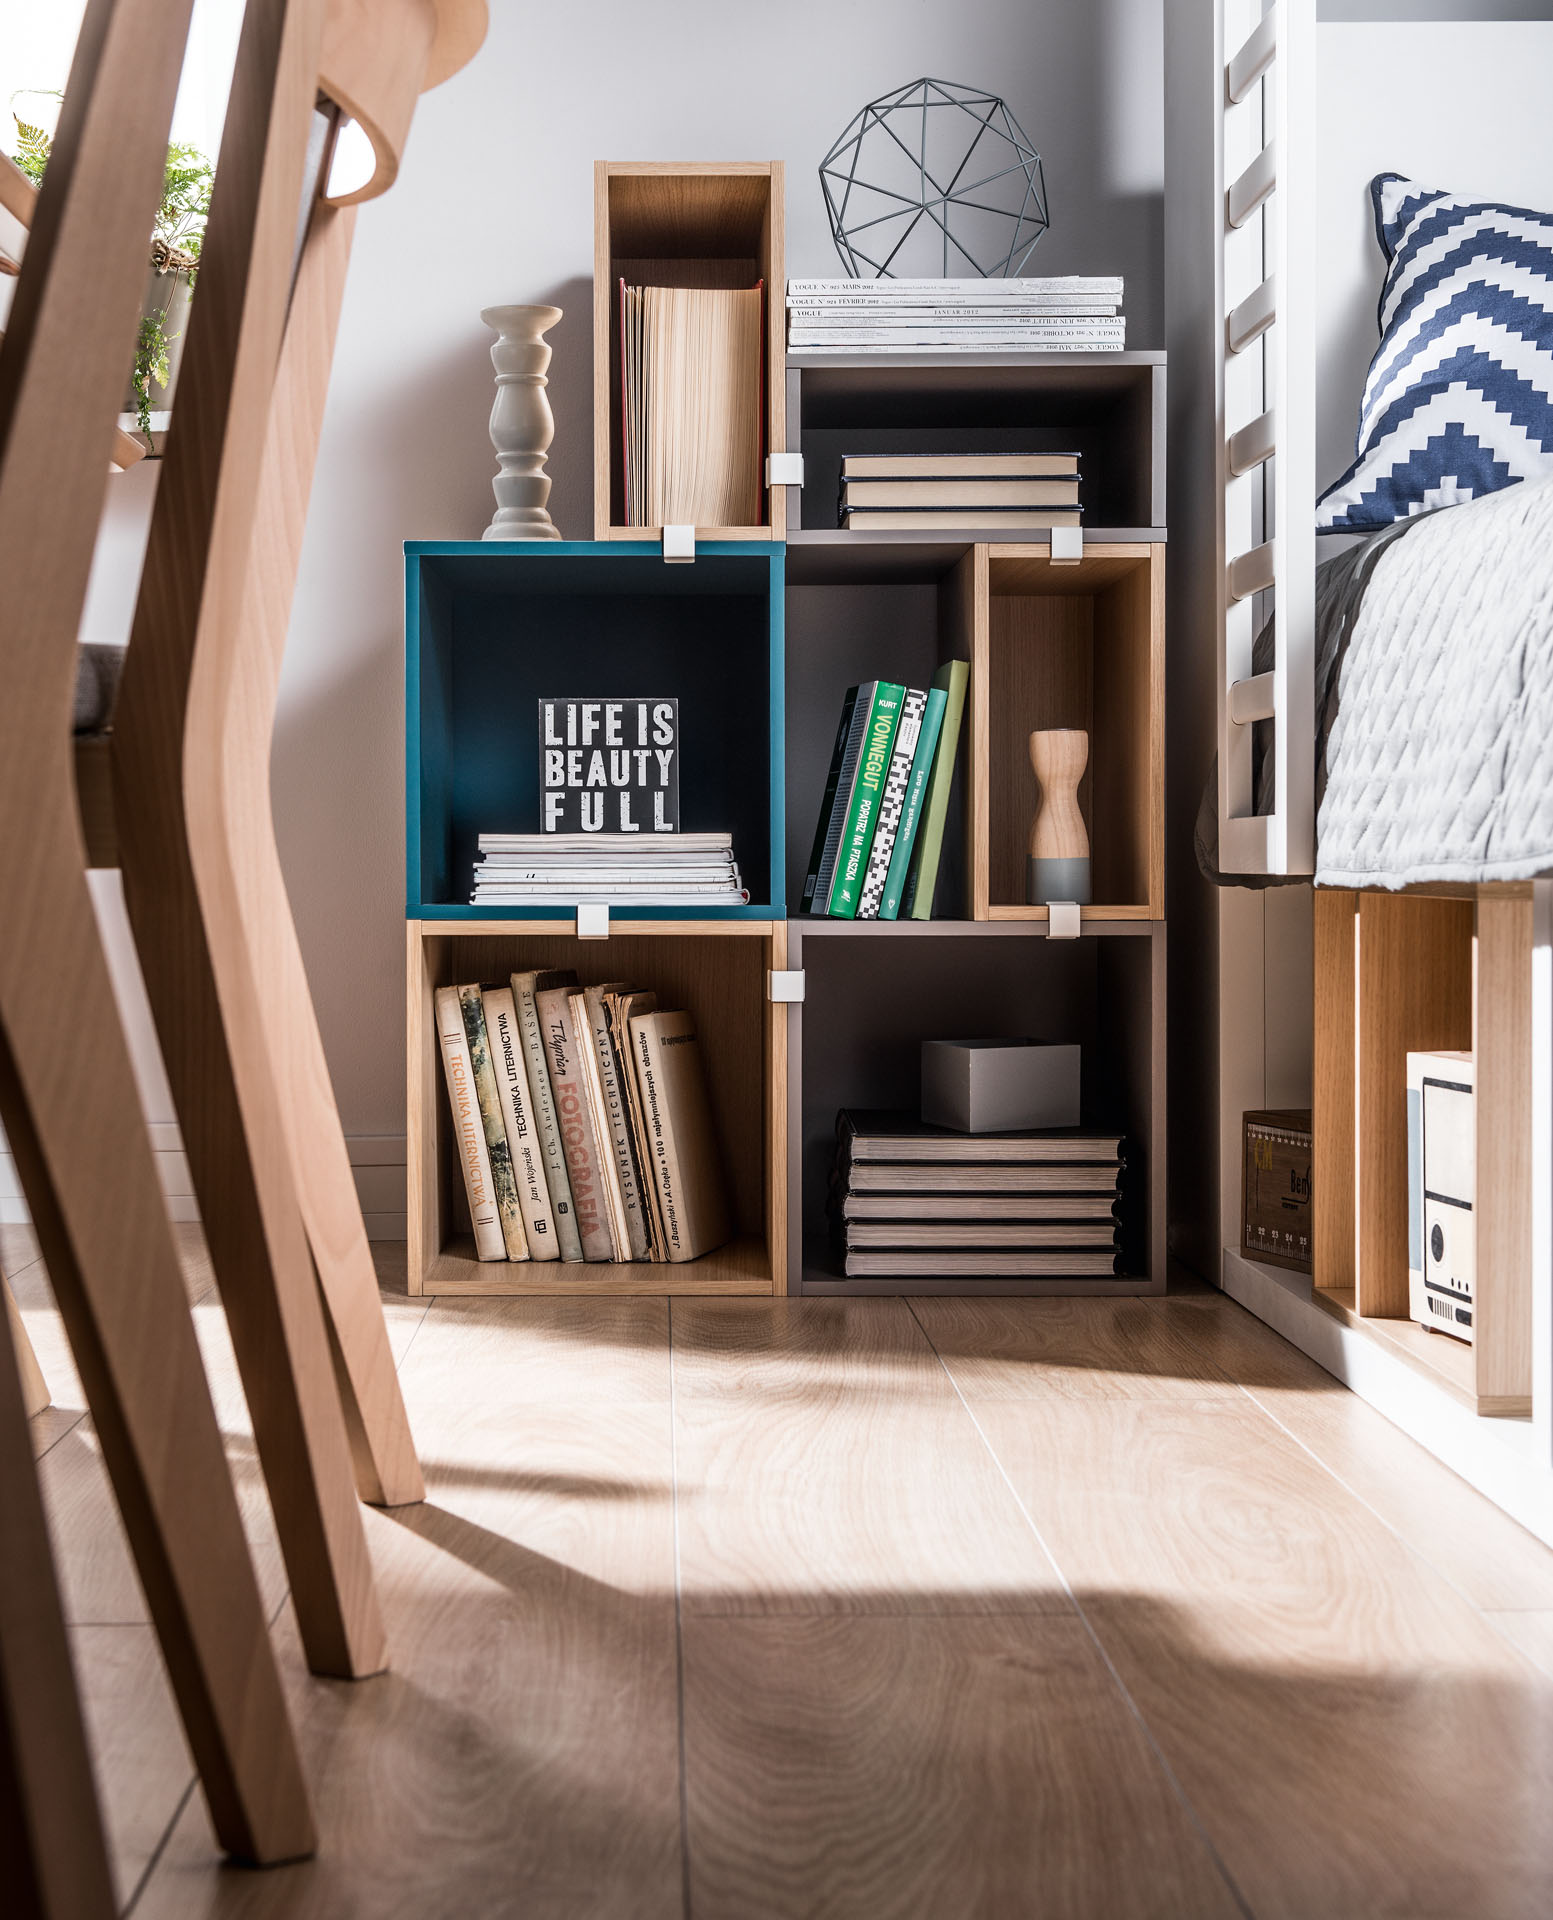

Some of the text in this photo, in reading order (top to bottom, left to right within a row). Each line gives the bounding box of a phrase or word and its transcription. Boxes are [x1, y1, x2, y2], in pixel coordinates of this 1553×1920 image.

[545, 703, 674, 746] LIFE IS
[878, 699, 897, 709] KURT
[545, 750, 674, 787] BEAUTY
[545, 792, 673, 832] FULL
[845, 715, 893, 881] VONNEGUT POPATRZ NA PTASZKA
[639, 1031, 651, 1068] obrazów
[522, 991, 561, 1170] J. Ch. Andersen BAŚNIE
[497, 1012, 542, 1203] Jan Wojeński TECHNIKA LITERNICTWA
[596, 1028, 636, 1209] RYSUNEK TECHNICZNY
[450, 1053, 488, 1208] TECHNIKA LITERNICTWA
[656, 1140, 665, 1157] 100
[557, 1081, 600, 1238] FOTOGRAFIA
[1254, 1139, 1273, 1170] CM
[1258, 1226, 1265, 1236] 22
[1271, 1230, 1279, 1239] 23
[1285, 1233, 1293, 1242] 24
